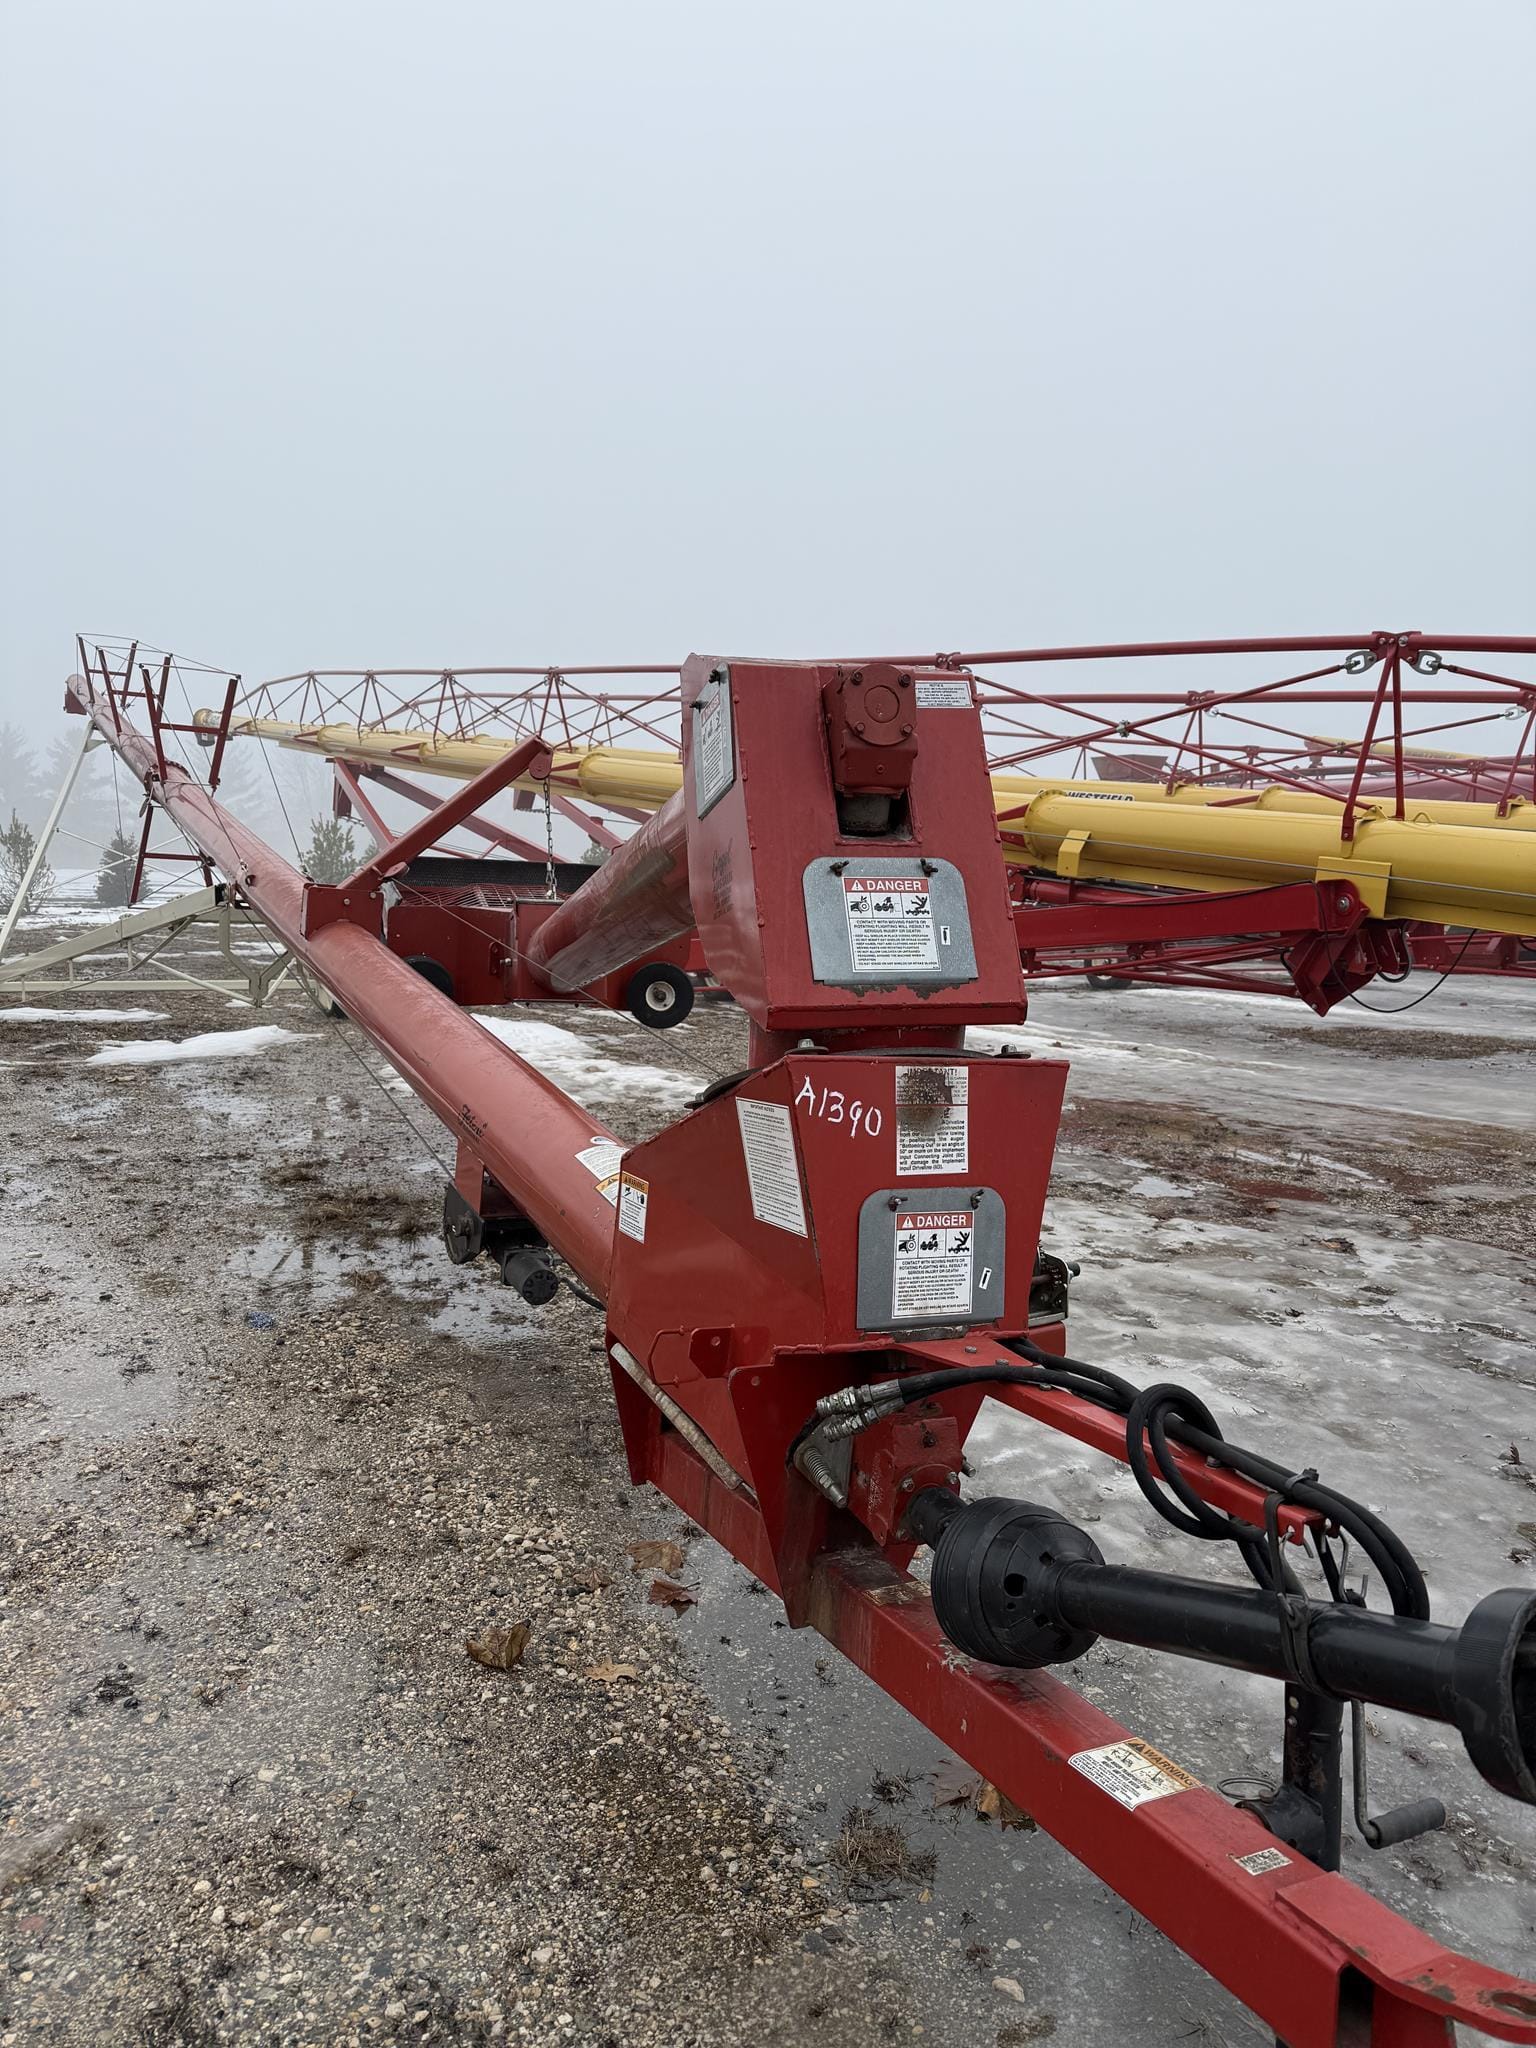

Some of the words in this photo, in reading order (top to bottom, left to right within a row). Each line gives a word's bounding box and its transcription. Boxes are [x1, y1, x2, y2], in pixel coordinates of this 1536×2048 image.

[866, 880, 922, 891] DANGER
[795, 1074, 882, 1138] A1390
[916, 1215, 967, 1227] DANGER
[1144, 1749, 1194, 1786] WARNING
